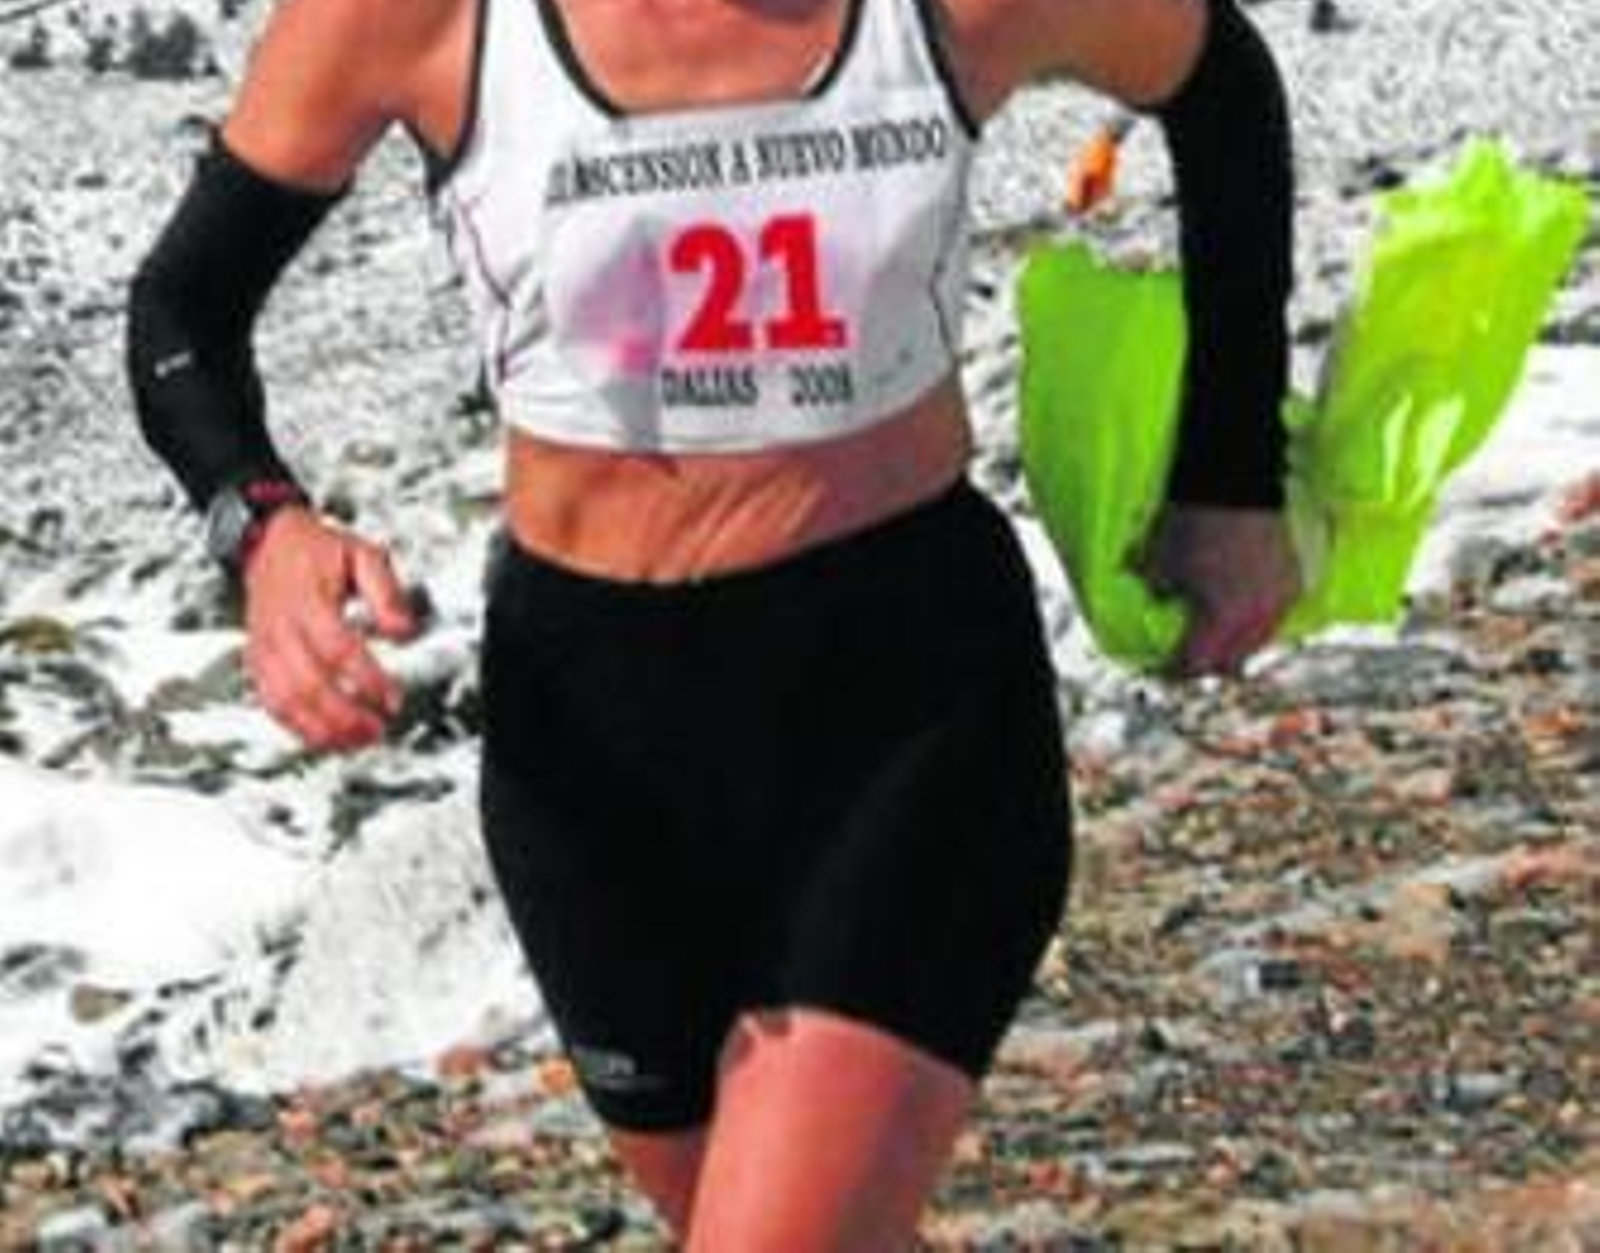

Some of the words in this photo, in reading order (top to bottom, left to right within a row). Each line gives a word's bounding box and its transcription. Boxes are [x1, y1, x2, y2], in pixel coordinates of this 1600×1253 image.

[733, 140, 751, 184] A
[756, 127, 846, 181] NUEVO
[852, 117, 946, 170] MUNDO
[669, 213, 847, 353] 21
